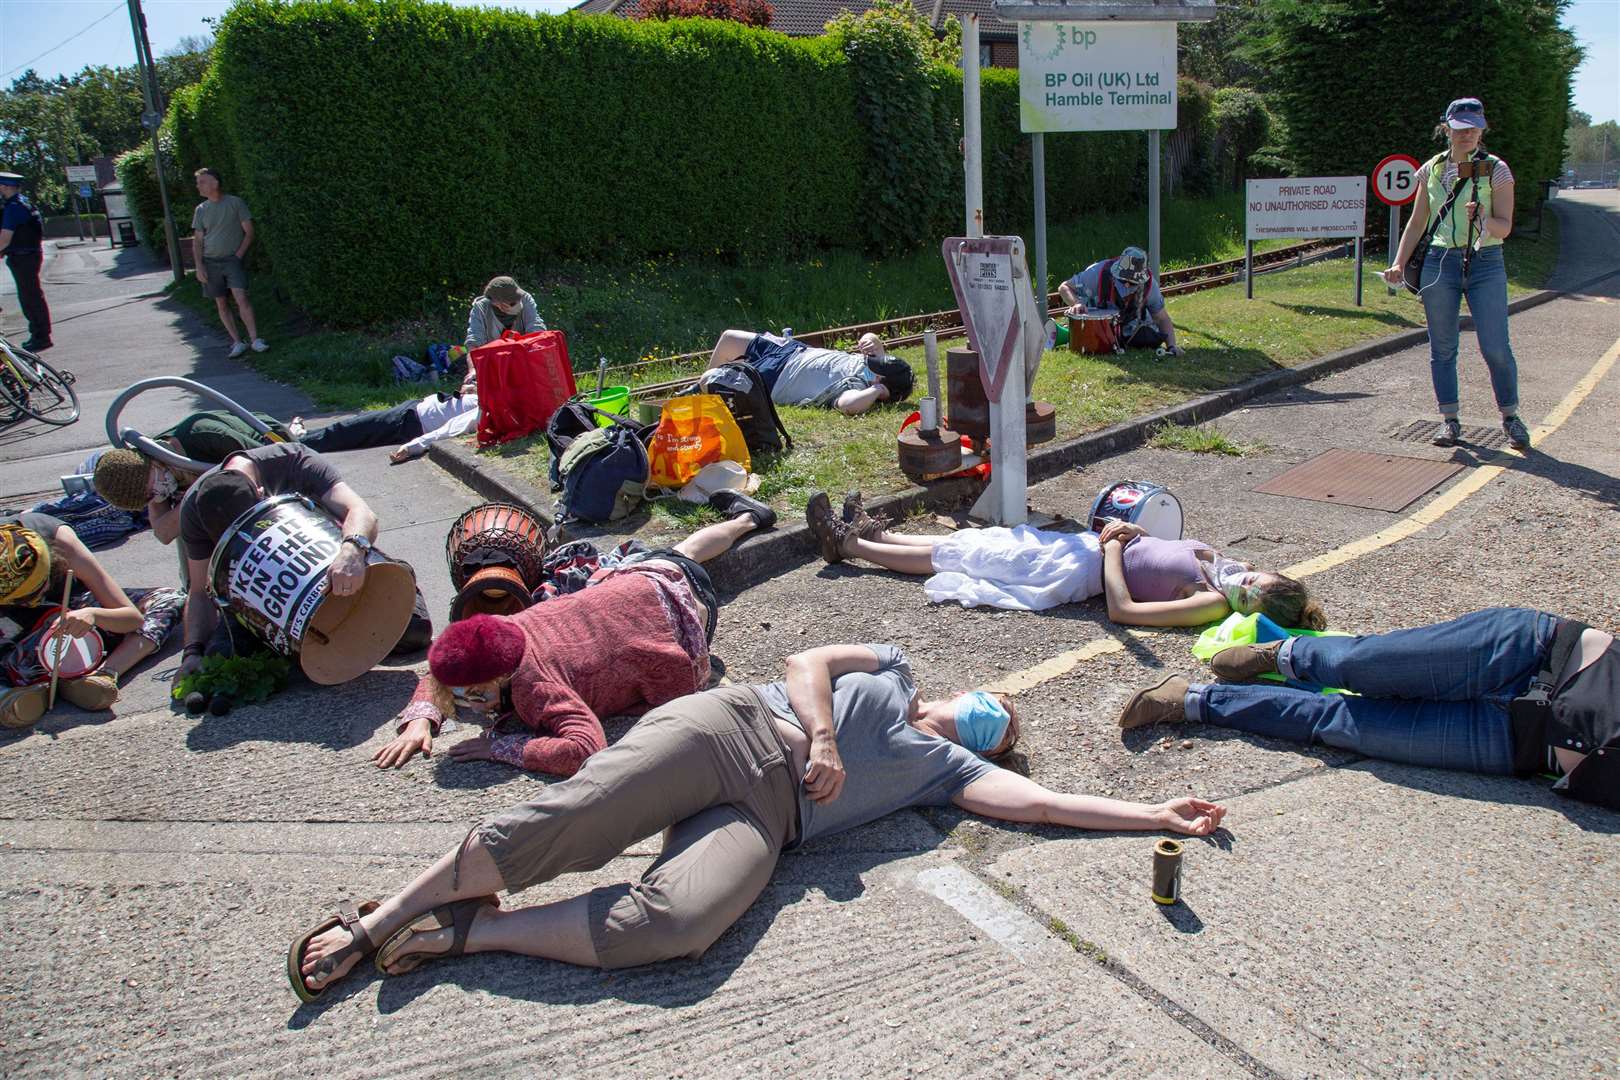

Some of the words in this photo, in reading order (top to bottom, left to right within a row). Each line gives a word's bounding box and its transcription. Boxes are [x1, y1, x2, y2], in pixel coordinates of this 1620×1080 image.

[1072, 26, 1096, 50] bp
[1045, 73, 1067, 87] BP
[1072, 72, 1093, 87] Oil
[1098, 72, 1131, 90] (UK)
[1136, 72, 1159, 87] Ltd
[1045, 92, 1103, 106] Hamble
[1108, 91, 1171, 105] Terminal
[1279, 185, 1310, 196] PRIVATE
[1313, 184, 1336, 195] ROAD
[1384, 171, 1410, 190] 15
[1249, 202, 1262, 212] NO
[1264, 200, 1329, 211] UNAUTHORISED
[1331, 199, 1365, 209] ACCESS
[235, 536, 273, 593] KEEP
[277, 519, 302, 535] IT
[250, 569, 272, 598] IN
[267, 531, 312, 565] THE
[264, 540, 338, 618] GROUND
[291, 617, 303, 638] IT'S
